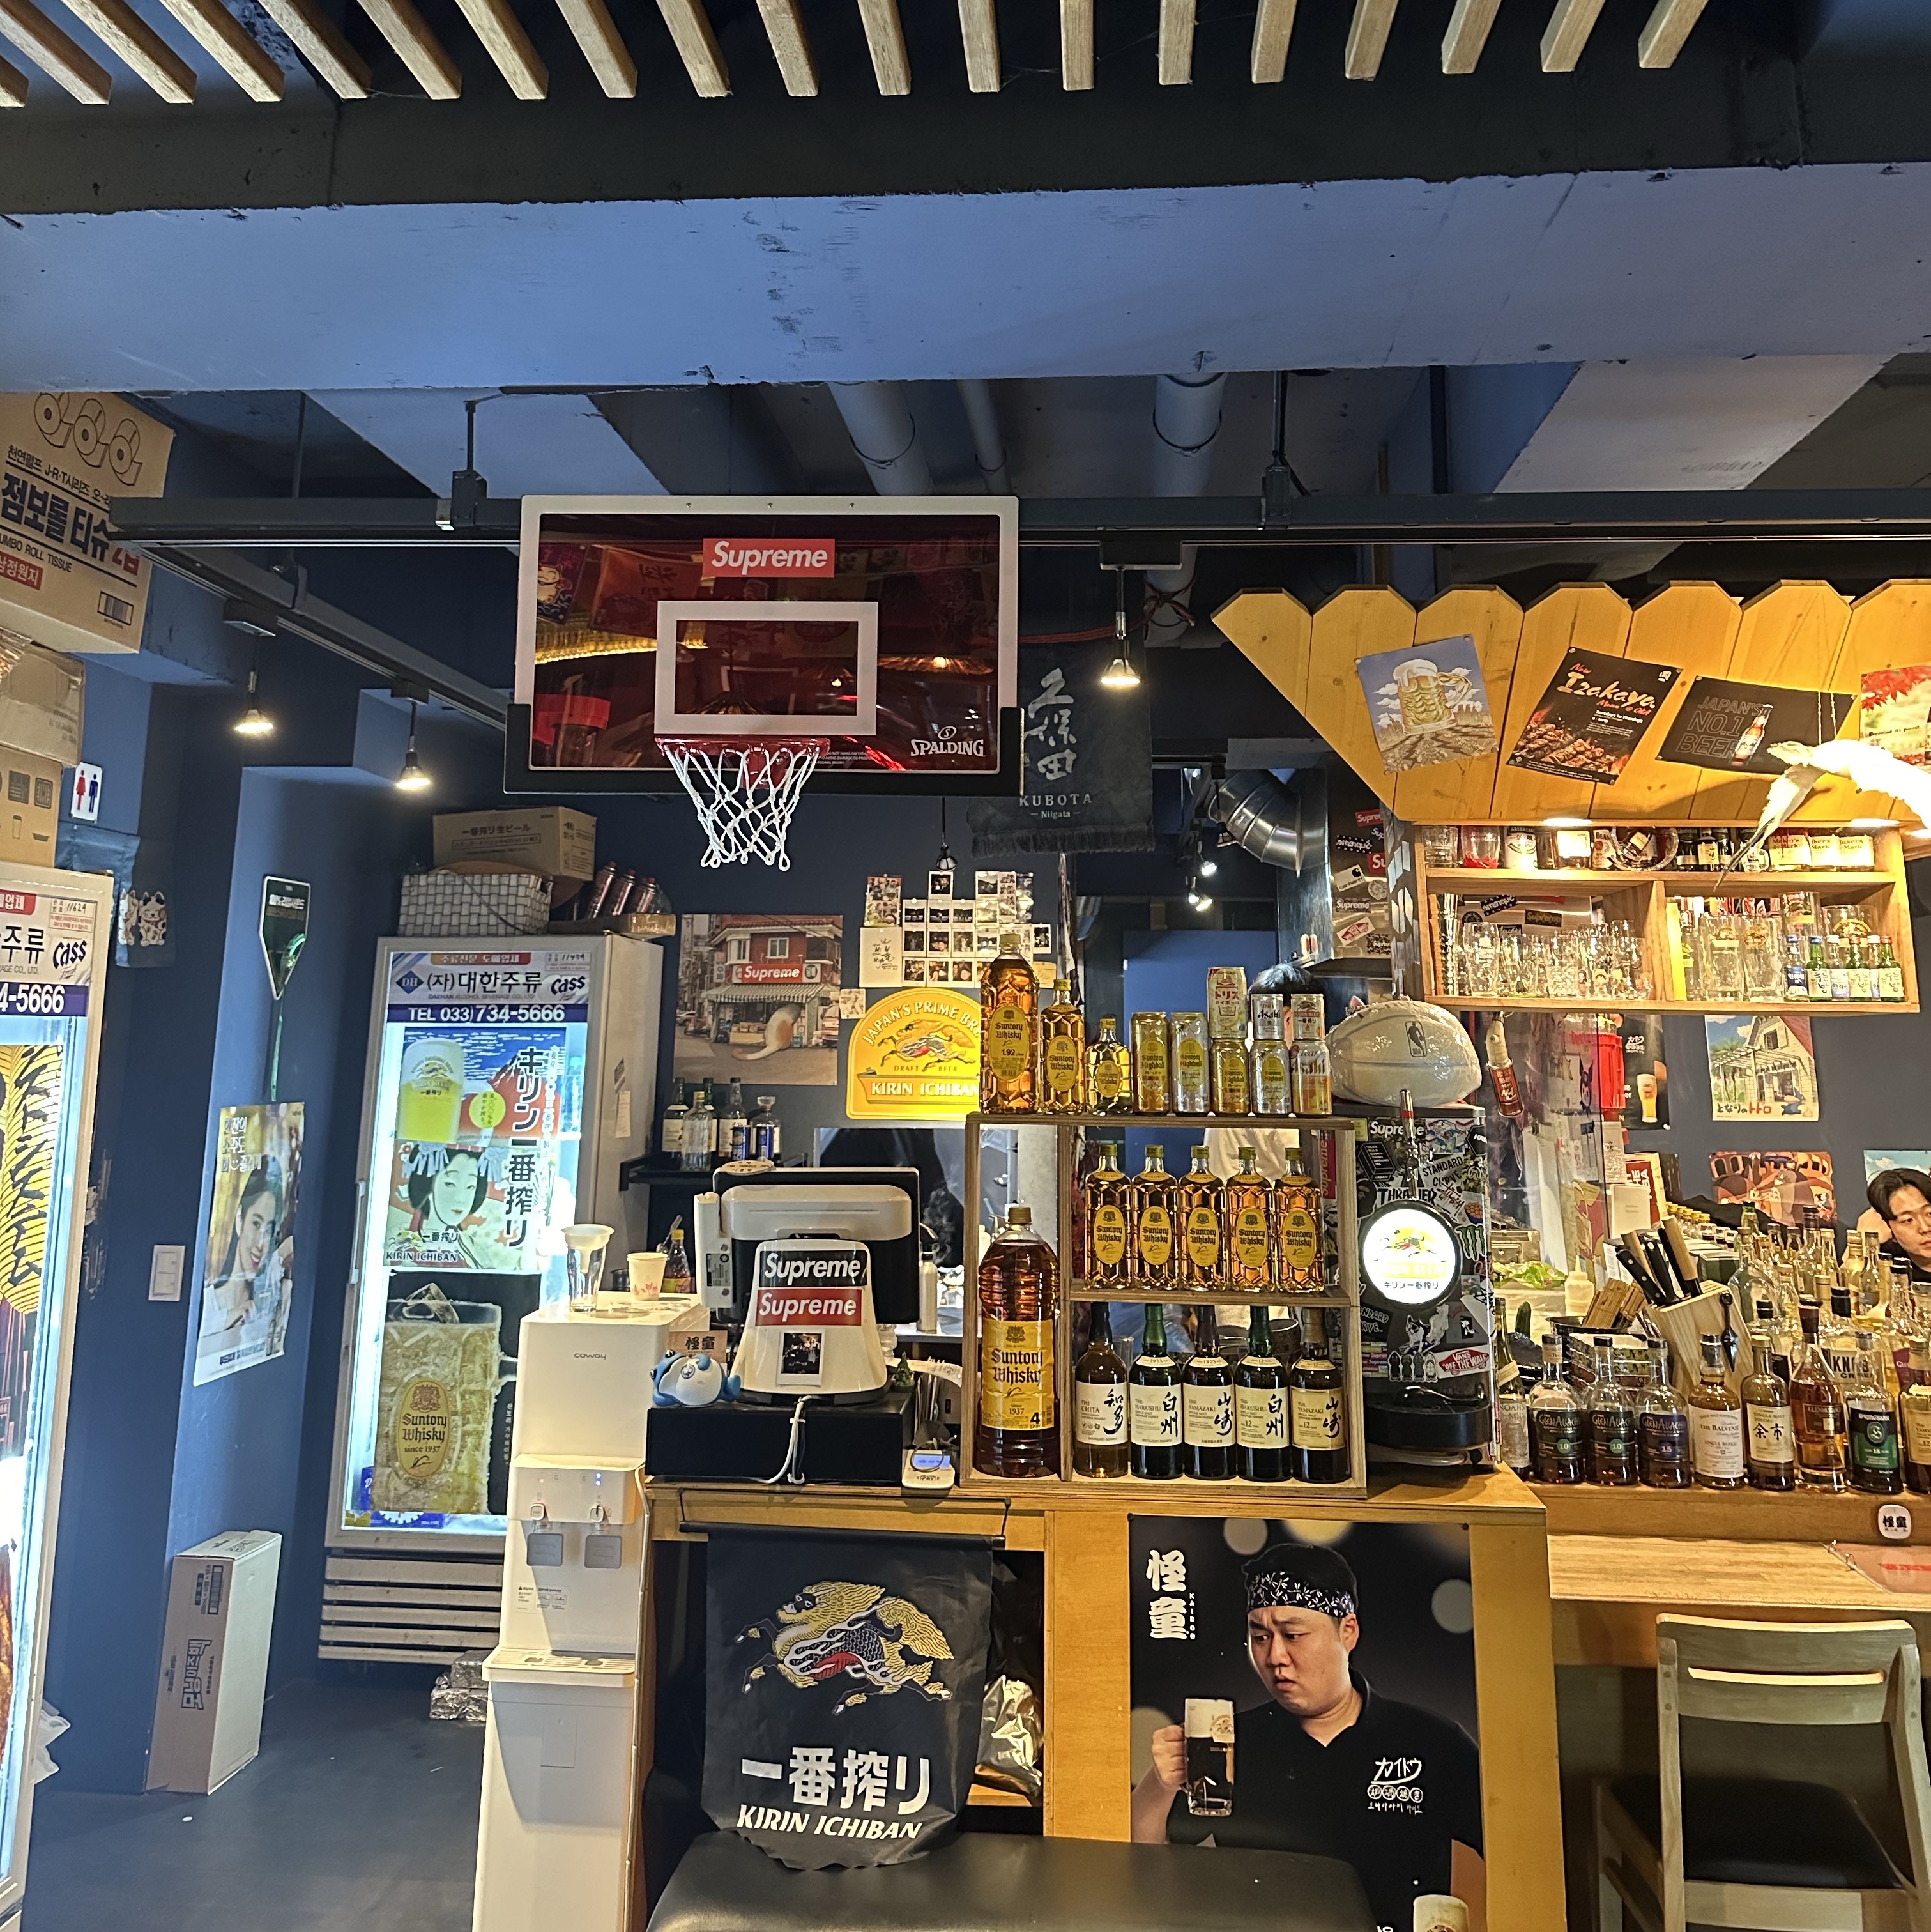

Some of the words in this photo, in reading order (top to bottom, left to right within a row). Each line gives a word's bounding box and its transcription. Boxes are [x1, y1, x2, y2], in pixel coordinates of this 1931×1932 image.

[1, 473, 70, 544] 점보롤
[70, 507, 110, 563] 티슈
[0, 533, 23, 551] UMBO
[25, 545, 44, 561] ROLL
[48, 553, 72, 572] TISSUE
[711, 540, 828, 576] Supreme
[1557, 672, 1656, 709] Izakaya
[1698, 696, 1765, 717] JAPAN'S
[1023, 667, 1077, 781] 久保田
[1687, 710, 1745, 737] NO.1
[910, 739, 986, 757] SPALDING
[1020, 793, 1094, 808] KUBOTA
[1041, 809, 1071, 820] Niigata
[0, 925, 45, 965] 주류
[744, 965, 800, 981] Supreme
[401, 976, 418, 988] DH
[1214, 990, 1240, 1000] トリス
[408, 1007, 436, 1022] TEL
[1257, 1009, 1281, 1020] Asahi
[862, 1002, 912, 1046] JAPAN'S
[914, 1000, 959, 1022] PRIME
[959, 1013, 981, 1038] BRE
[995, 1022, 1023, 1031] Suntory
[995, 1031, 1023, 1041] Whisky
[1049, 1055, 1075, 1063] Suntory
[1049, 1062, 1074, 1073] Whisky
[871, 1082, 913, 1096] KIRIN
[1716, 1101, 1772, 1114] となりのトトロ
[1370, 1121, 1425, 1138] Supree
[505, 1047, 544, 1248] キリン一番搾り
[1422, 1156, 1463, 1177] STANDARD
[1377, 1187, 1438, 1206] THRAER
[1096, 1225, 1122, 1234] Suntory
[1142, 1225, 1169, 1235] Suntory
[1189, 1227, 1217, 1237] Suntory
[1238, 1228, 1265, 1238] Suntory
[1285, 1229, 1313, 1239] Suntory
[422, 1232, 459, 1243] 一番搾り
[1097, 1234, 1122, 1243] Whisky
[1143, 1234, 1168, 1244] Whisky
[1191, 1236, 1216, 1245] Whisky
[1239, 1237, 1265, 1246] Whisky
[1286, 1238, 1312, 1247] Whisky
[386, 1252, 413, 1261] KIRIN
[417, 1252, 458, 1262] ICHIBAN
[764, 1252, 862, 1286] Supreme
[1384, 1282, 1439, 1290] キリン一番搾り
[759, 1292, 857, 1322] Supreme
[991, 1347, 1043, 1366] Suntory
[1452, 1351, 1472, 1361] VANS
[1832, 1355, 1870, 1373] KNB
[991, 1366, 1042, 1386] Whisky
[1081, 1406, 1100, 1414] CHITA
[1103, 1388, 1124, 1436] 知多
[1161, 1392, 1178, 1438] 白州
[1189, 1404, 1216, 1413] YAMAZAKI
[1214, 1392, 1233, 1436] 山崎
[1266, 1393, 1284, 1439] 白州
[1297, 1406, 1324, 1414] YAMAZAKI
[402, 1413, 448, 1429] Suntory
[1030, 1411, 1041, 1425] 4
[1245, 1420, 1252, 1428] 12
[1323, 1397, 1341, 1439] 山崎
[402, 1428, 446, 1443] Whisky
[1752, 1423, 1785, 1441] 余市
[1146, 1549, 1187, 1640] 怪童
[741, 1746, 931, 1816] 一番搾り
[736, 1804, 811, 1834] KIRIN
[814, 1814, 923, 1840] ICHIBAN
